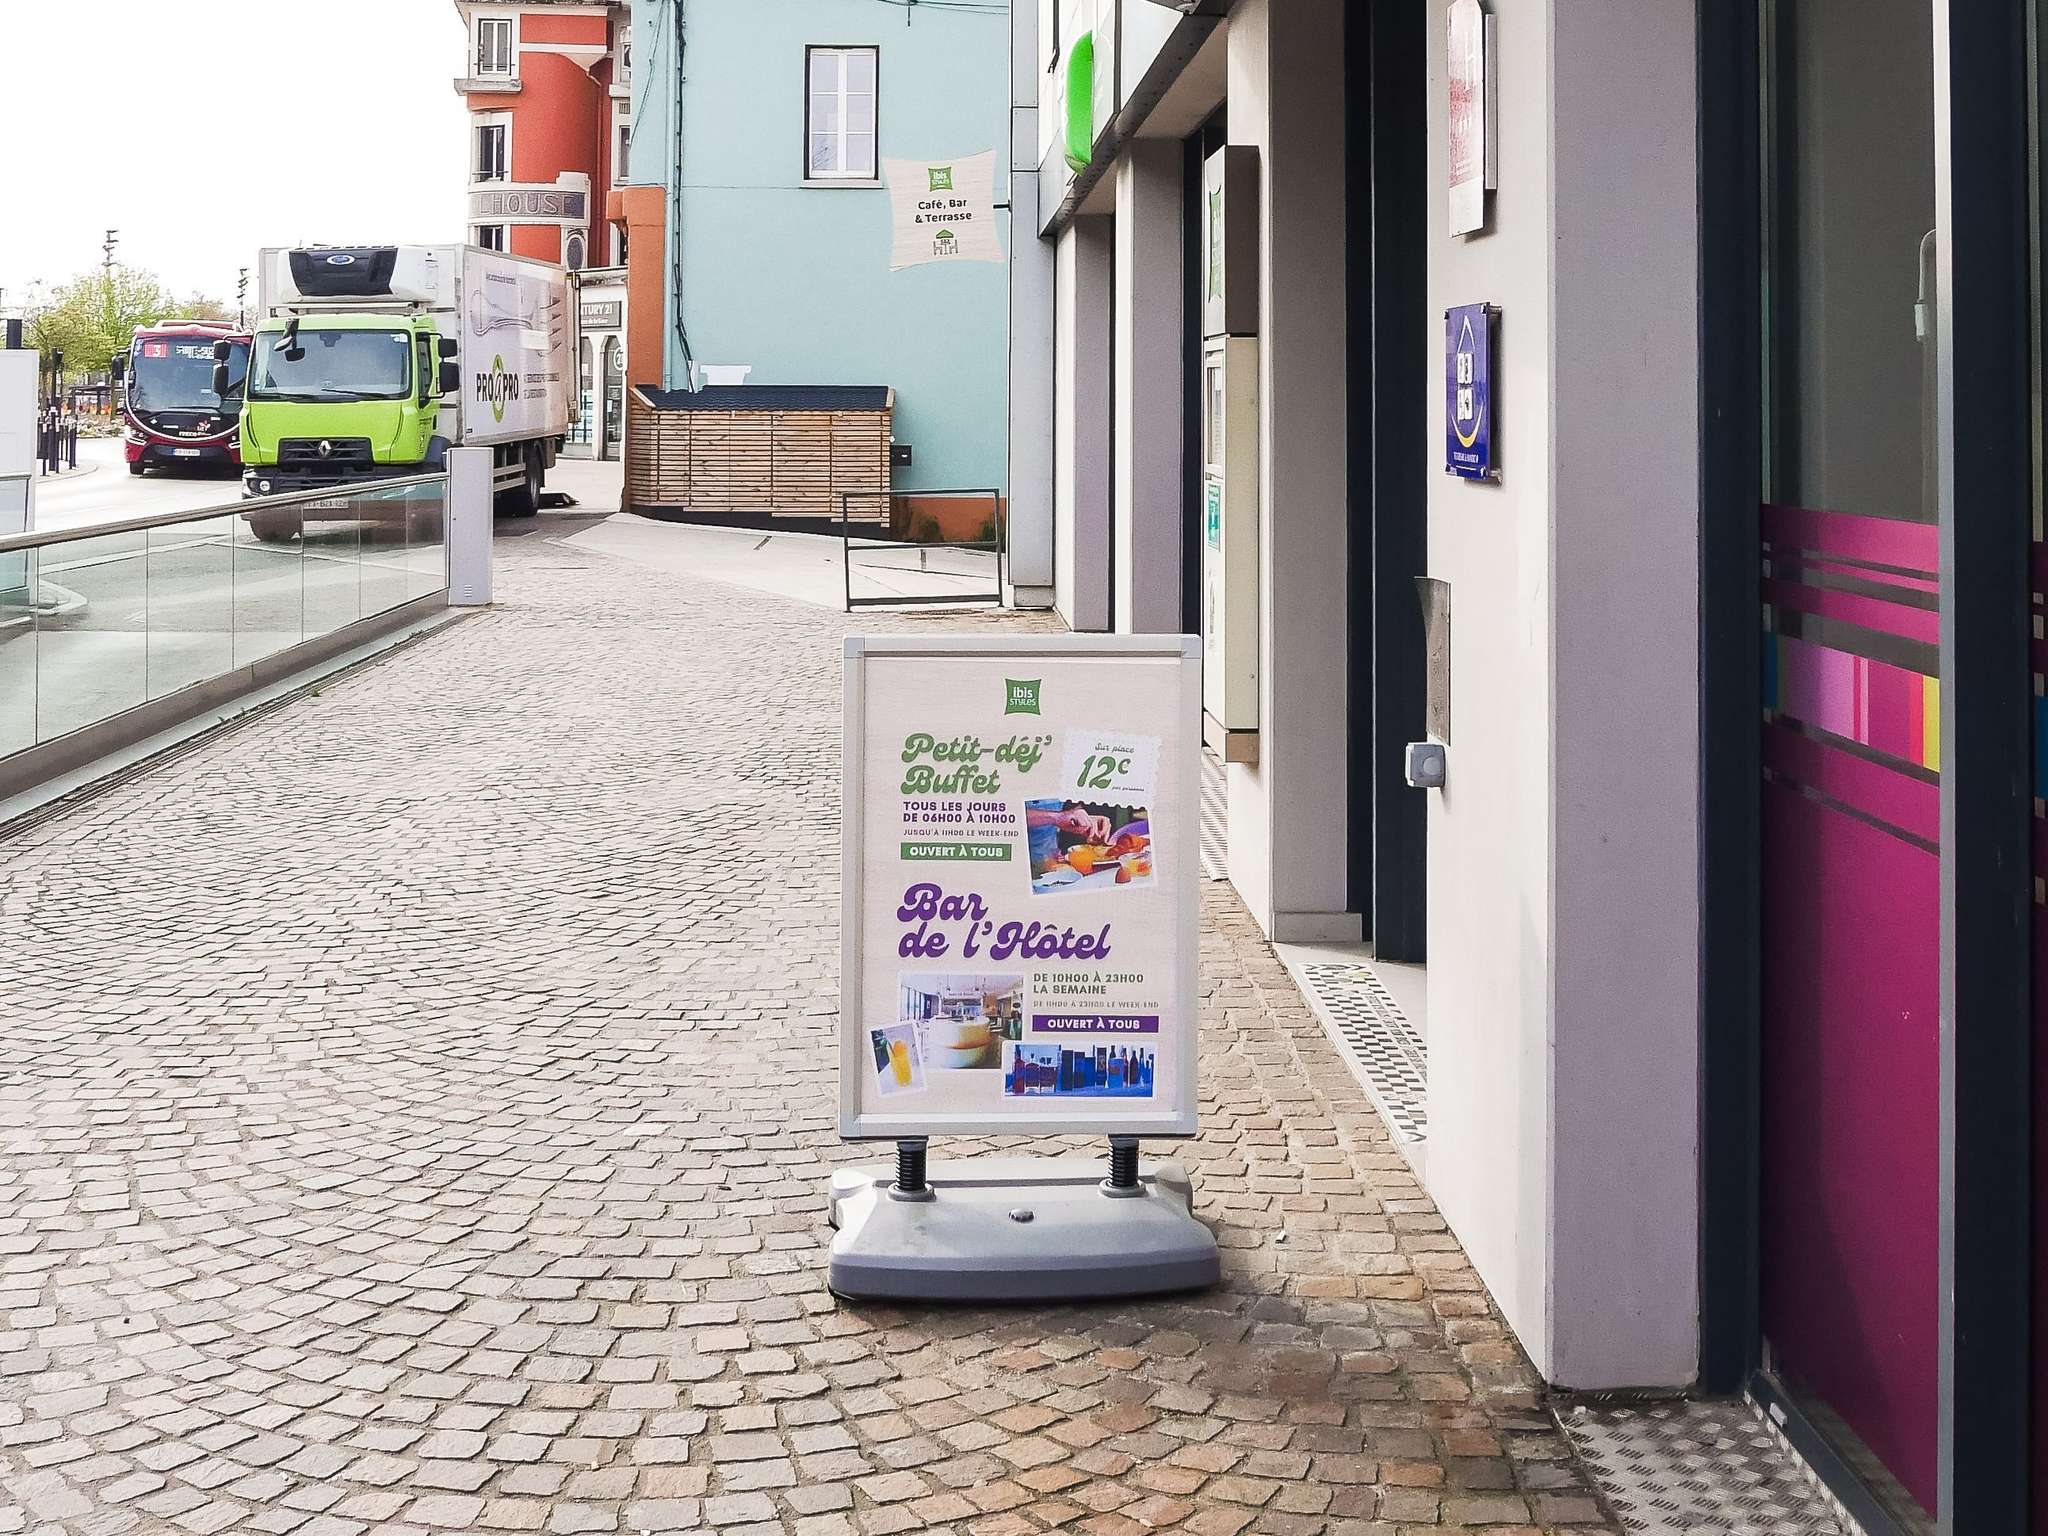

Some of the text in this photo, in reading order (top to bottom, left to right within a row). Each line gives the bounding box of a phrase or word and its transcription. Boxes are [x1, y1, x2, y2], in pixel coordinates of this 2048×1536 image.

[918, 199, 967, 210] Café, Bar
[914, 212, 972, 223] & Terrasse
[1012, 686, 1033, 699] ibis
[901, 732, 1052, 773] Petit-déj'
[1095, 743, 1135, 753] Sur place
[900, 764, 1001, 795] Buffet
[903, 801, 1006, 812] TOUS LES JOURS
[903, 810, 1016, 824] DE 06H00 À 10H00
[909, 844, 1003, 857] OUVERT À TOUS
[896, 882, 989, 922] Bar
[898, 921, 1112, 960] de l'Hôtel
[1033, 971, 1144, 983] DE 10H00 À 23H00
[1033, 985, 1107, 995] LA SEMAINE
[1047, 1017, 1140, 1029] OUVERT À TOUS
